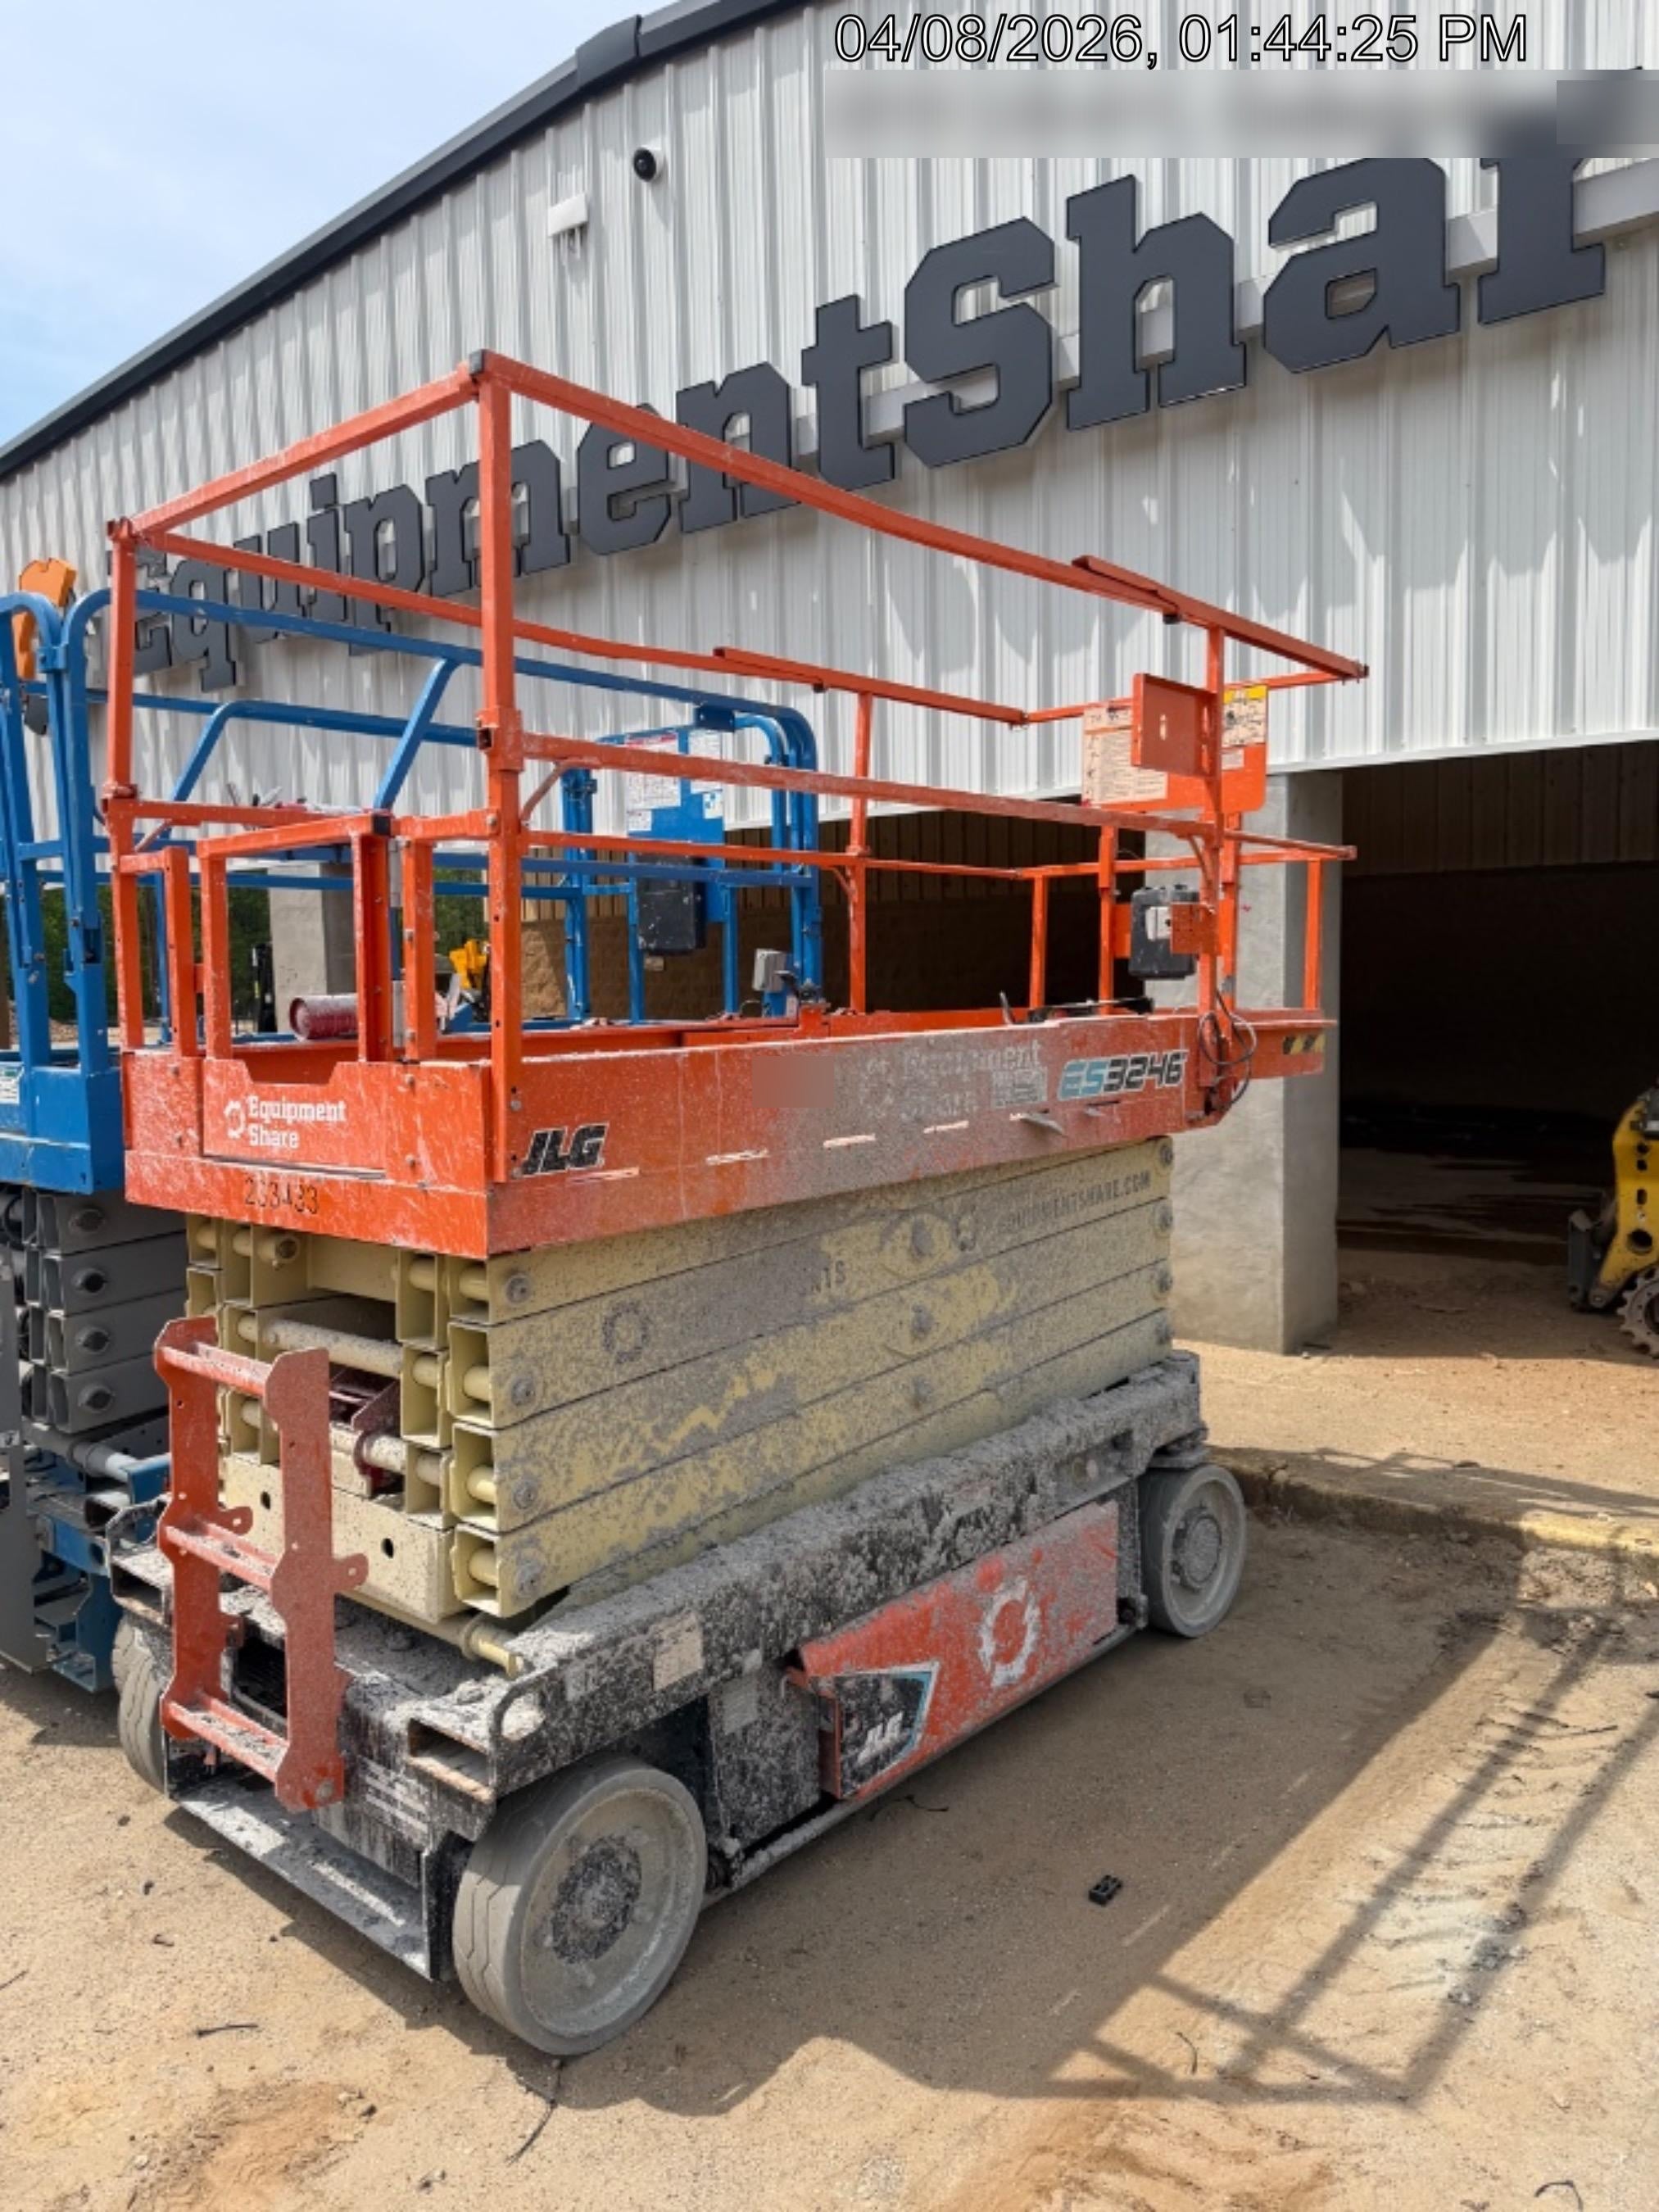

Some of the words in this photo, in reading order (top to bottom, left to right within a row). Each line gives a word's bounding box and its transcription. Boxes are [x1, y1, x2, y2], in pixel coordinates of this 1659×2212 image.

[1057, 1049, 1188, 1101] ES3246
[247, 1094, 347, 1124] Equipment
[248, 1123, 300, 1149] Share
[522, 1122, 610, 1178] JLG
